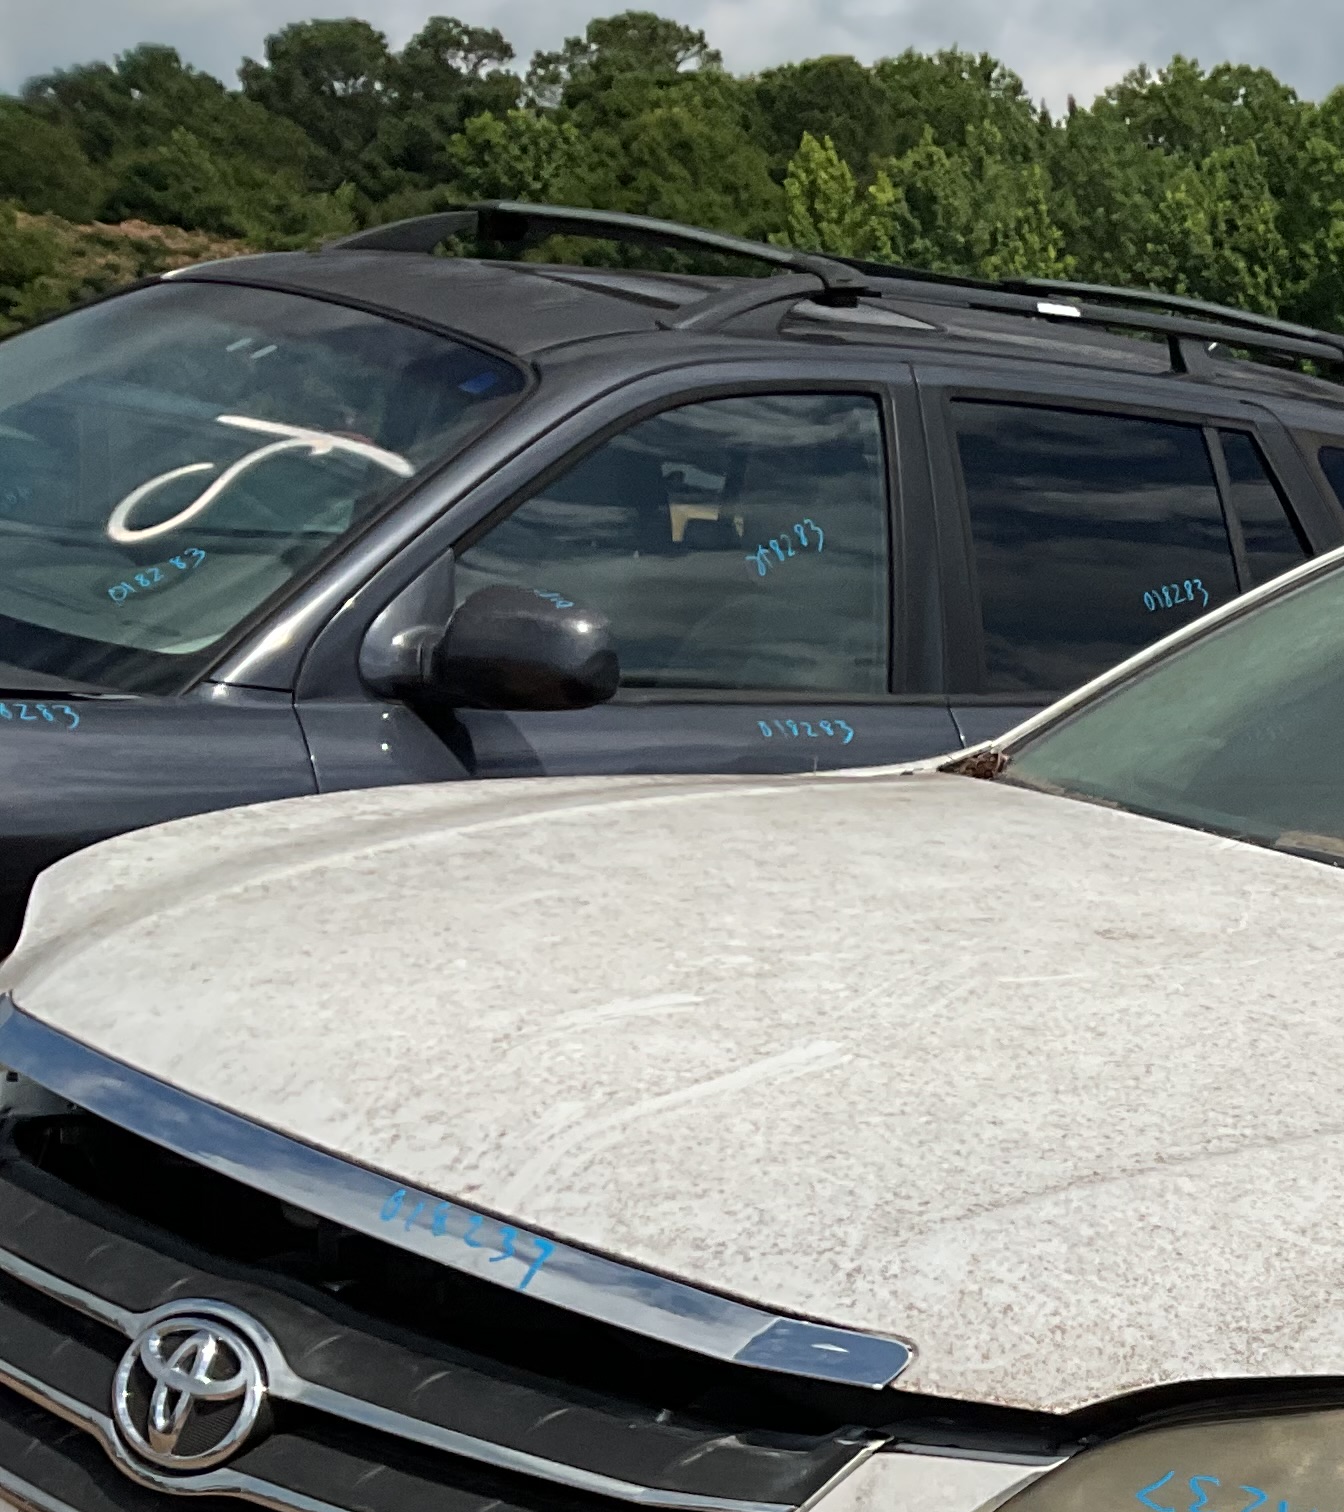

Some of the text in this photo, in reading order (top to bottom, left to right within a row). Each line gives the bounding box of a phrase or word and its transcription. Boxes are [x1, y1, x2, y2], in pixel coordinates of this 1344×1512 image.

[108, 547, 206, 607] 018283
[1143, 578, 1209, 612] 018283
[757, 719, 855, 744] 018283
[380, 1187, 558, 1290] 018237
